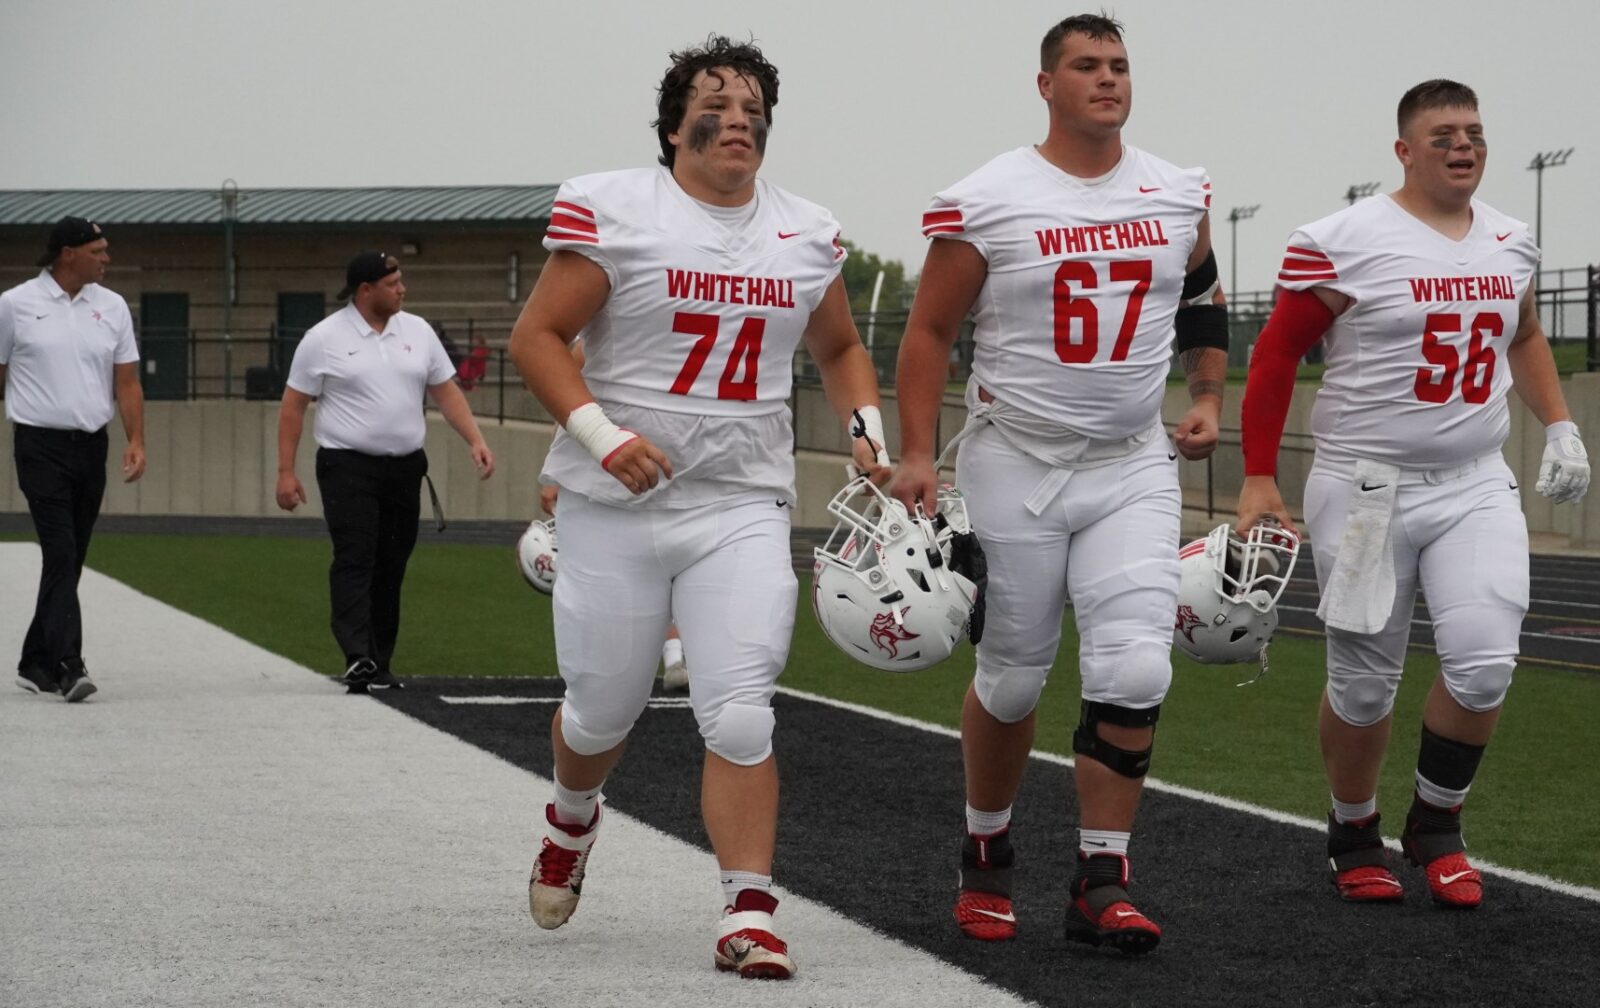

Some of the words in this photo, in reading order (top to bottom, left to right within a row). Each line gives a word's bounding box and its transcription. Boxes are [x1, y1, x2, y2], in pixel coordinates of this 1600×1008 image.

[1035, 220, 1169, 256] WHITEHALL
[666, 269, 795, 308] WHITEHALL
[1053, 259, 1152, 364] 67
[1409, 275, 1515, 302] WHITEHALL
[669, 311, 766, 401] 74
[1414, 311, 1504, 404] 56
